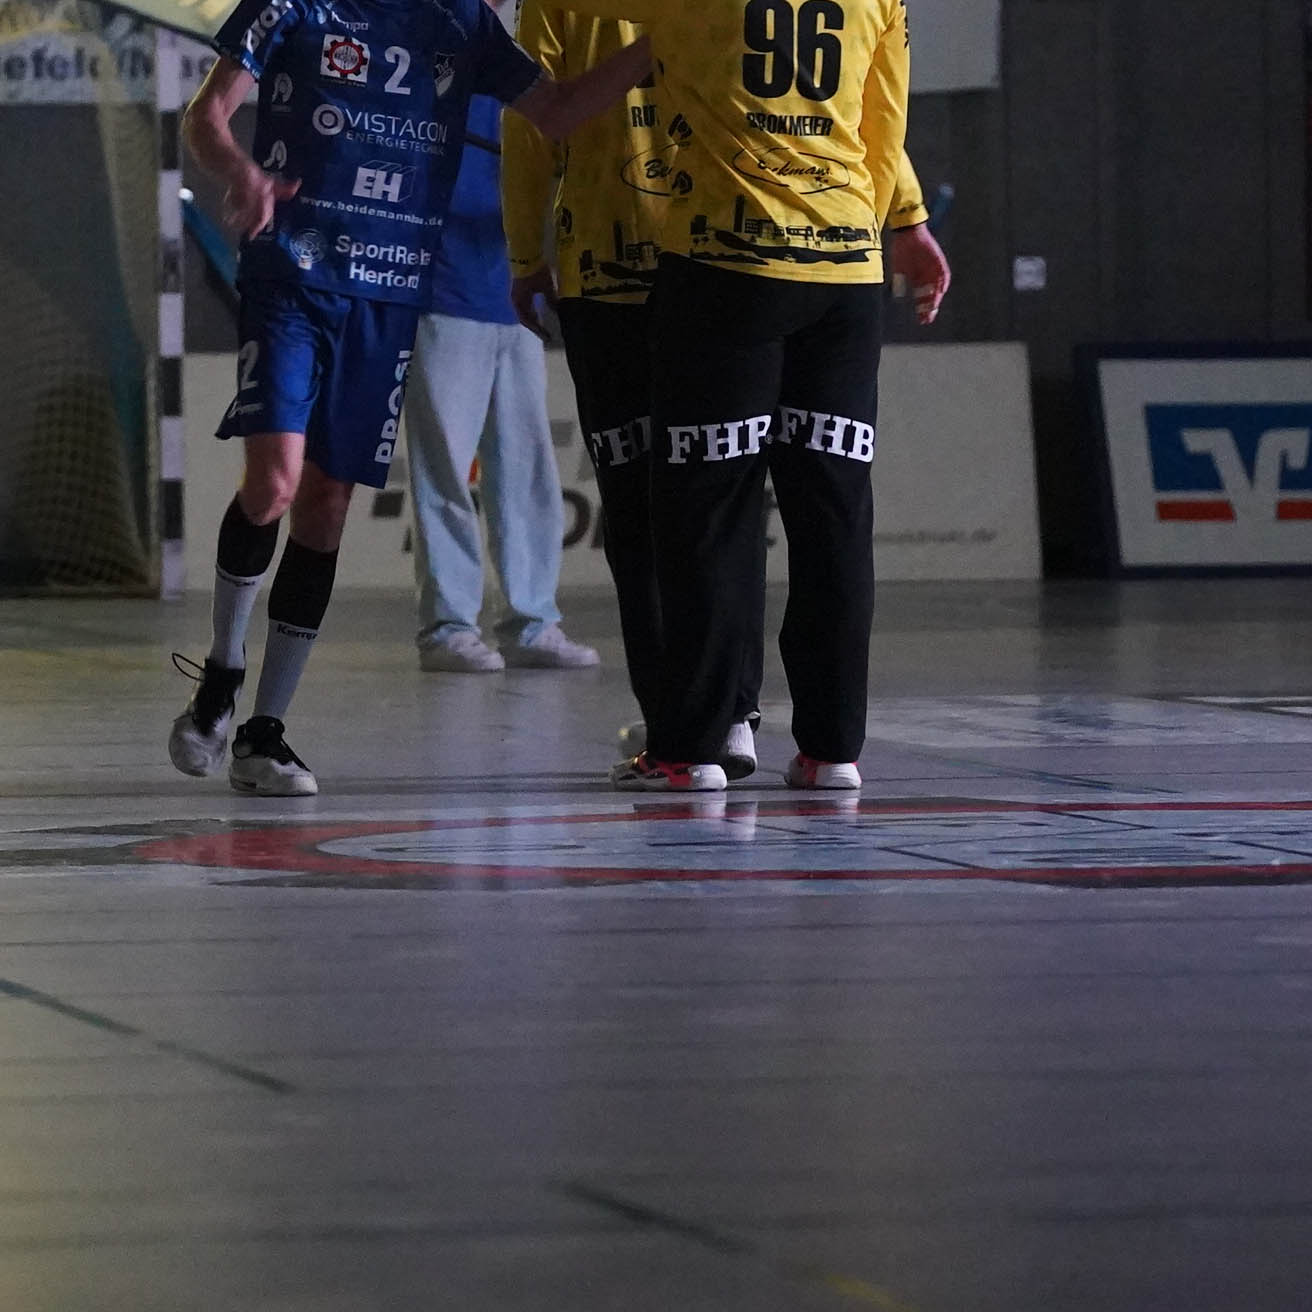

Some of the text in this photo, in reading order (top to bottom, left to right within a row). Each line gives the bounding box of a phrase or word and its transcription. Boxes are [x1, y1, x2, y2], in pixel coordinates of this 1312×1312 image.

[383, 45, 412, 96] 2
[345, 107, 448, 144] VISTACON
[351, 166, 405, 203] EH
[239, 339, 260, 391] 2
[779, 403, 876, 464] FHB
